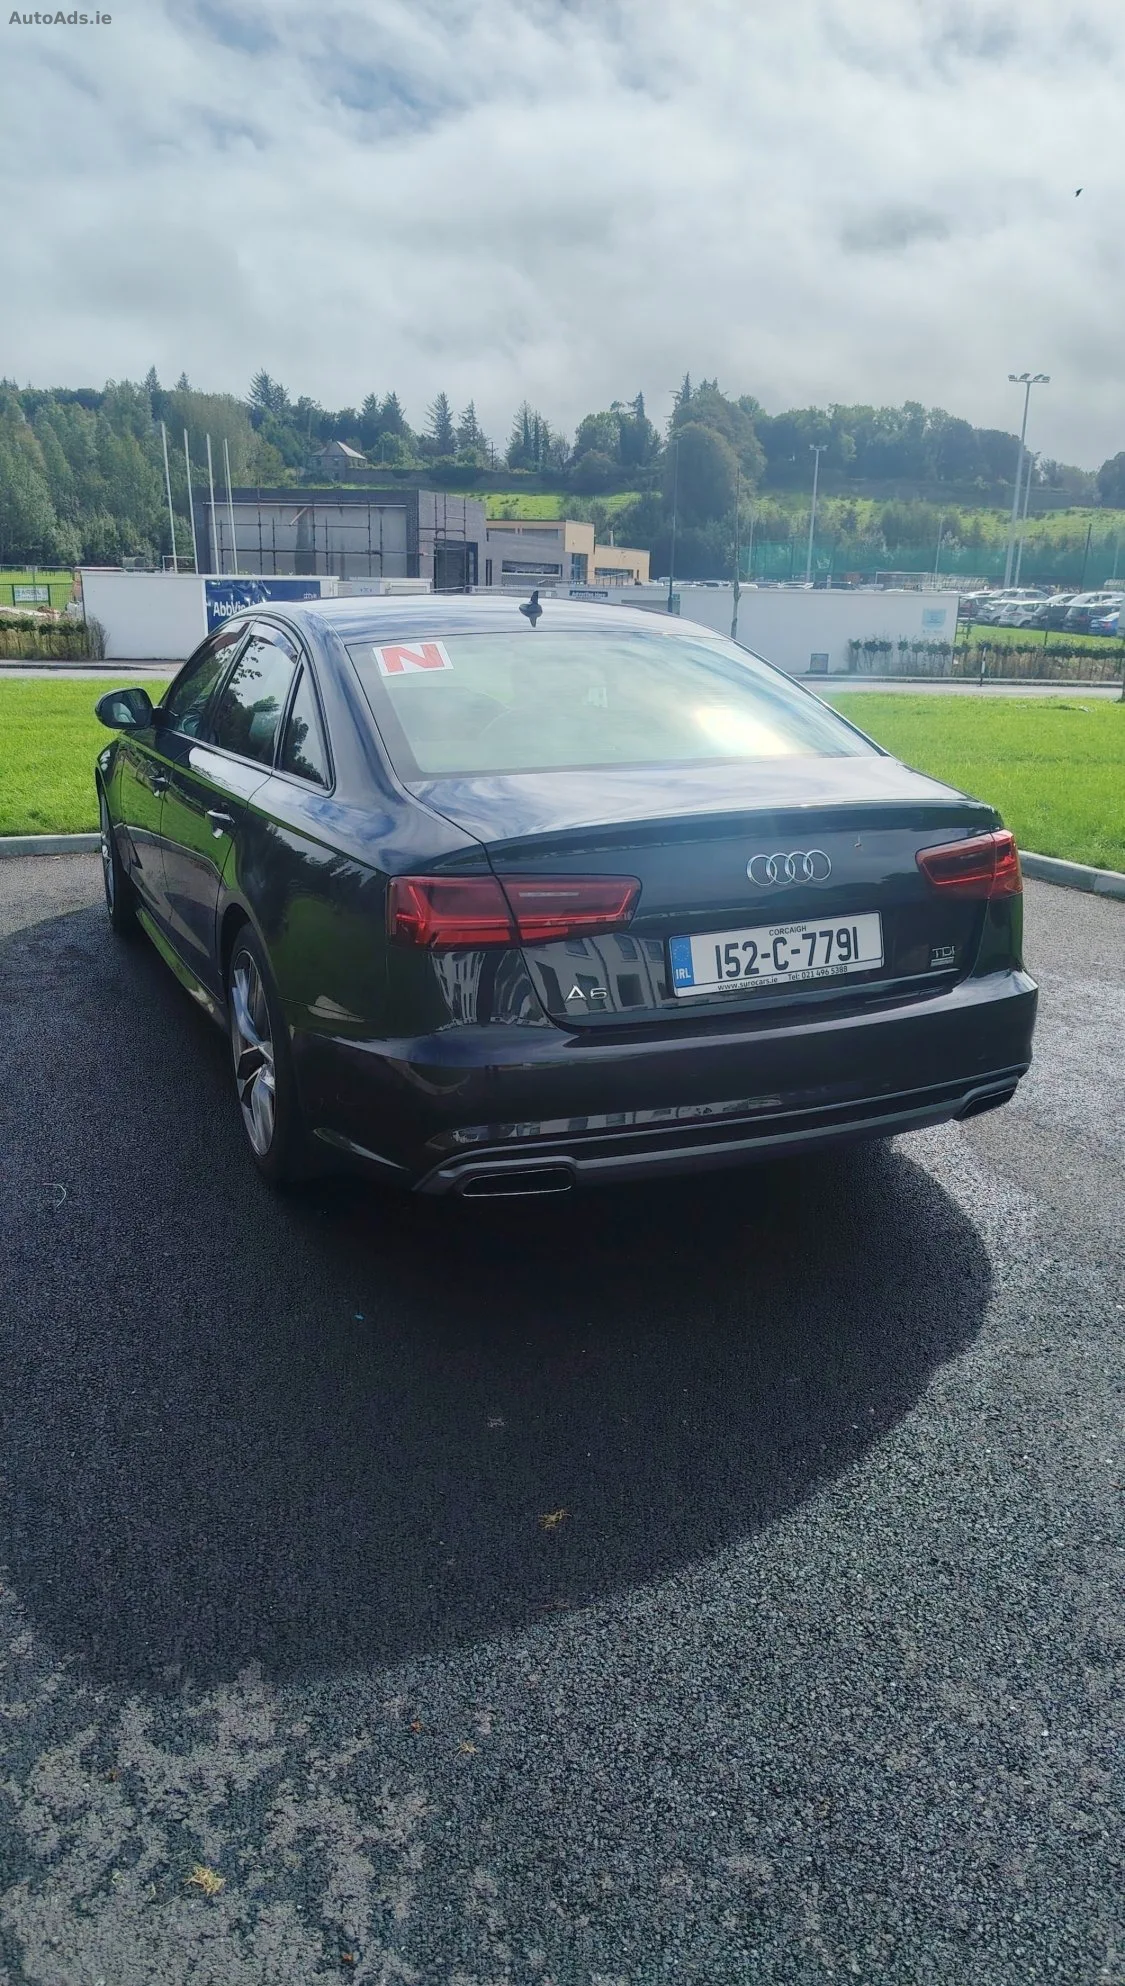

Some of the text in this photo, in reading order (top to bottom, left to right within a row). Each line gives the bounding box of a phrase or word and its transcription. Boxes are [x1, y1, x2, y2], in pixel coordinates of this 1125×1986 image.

[381, 643, 445, 673] N
[769, 925, 807, 937] CORCAIGH
[715, 926, 859, 980] 152-C-7791
[932, 946, 955, 958] TDI
[675, 968, 692, 980] IRL
[788, 973, 800, 981] Tel:
[801, 970, 814, 979] 021
[816, 968, 830, 977] 496
[831, 966, 848, 975] 5388
[565, 985, 608, 1002] A6
